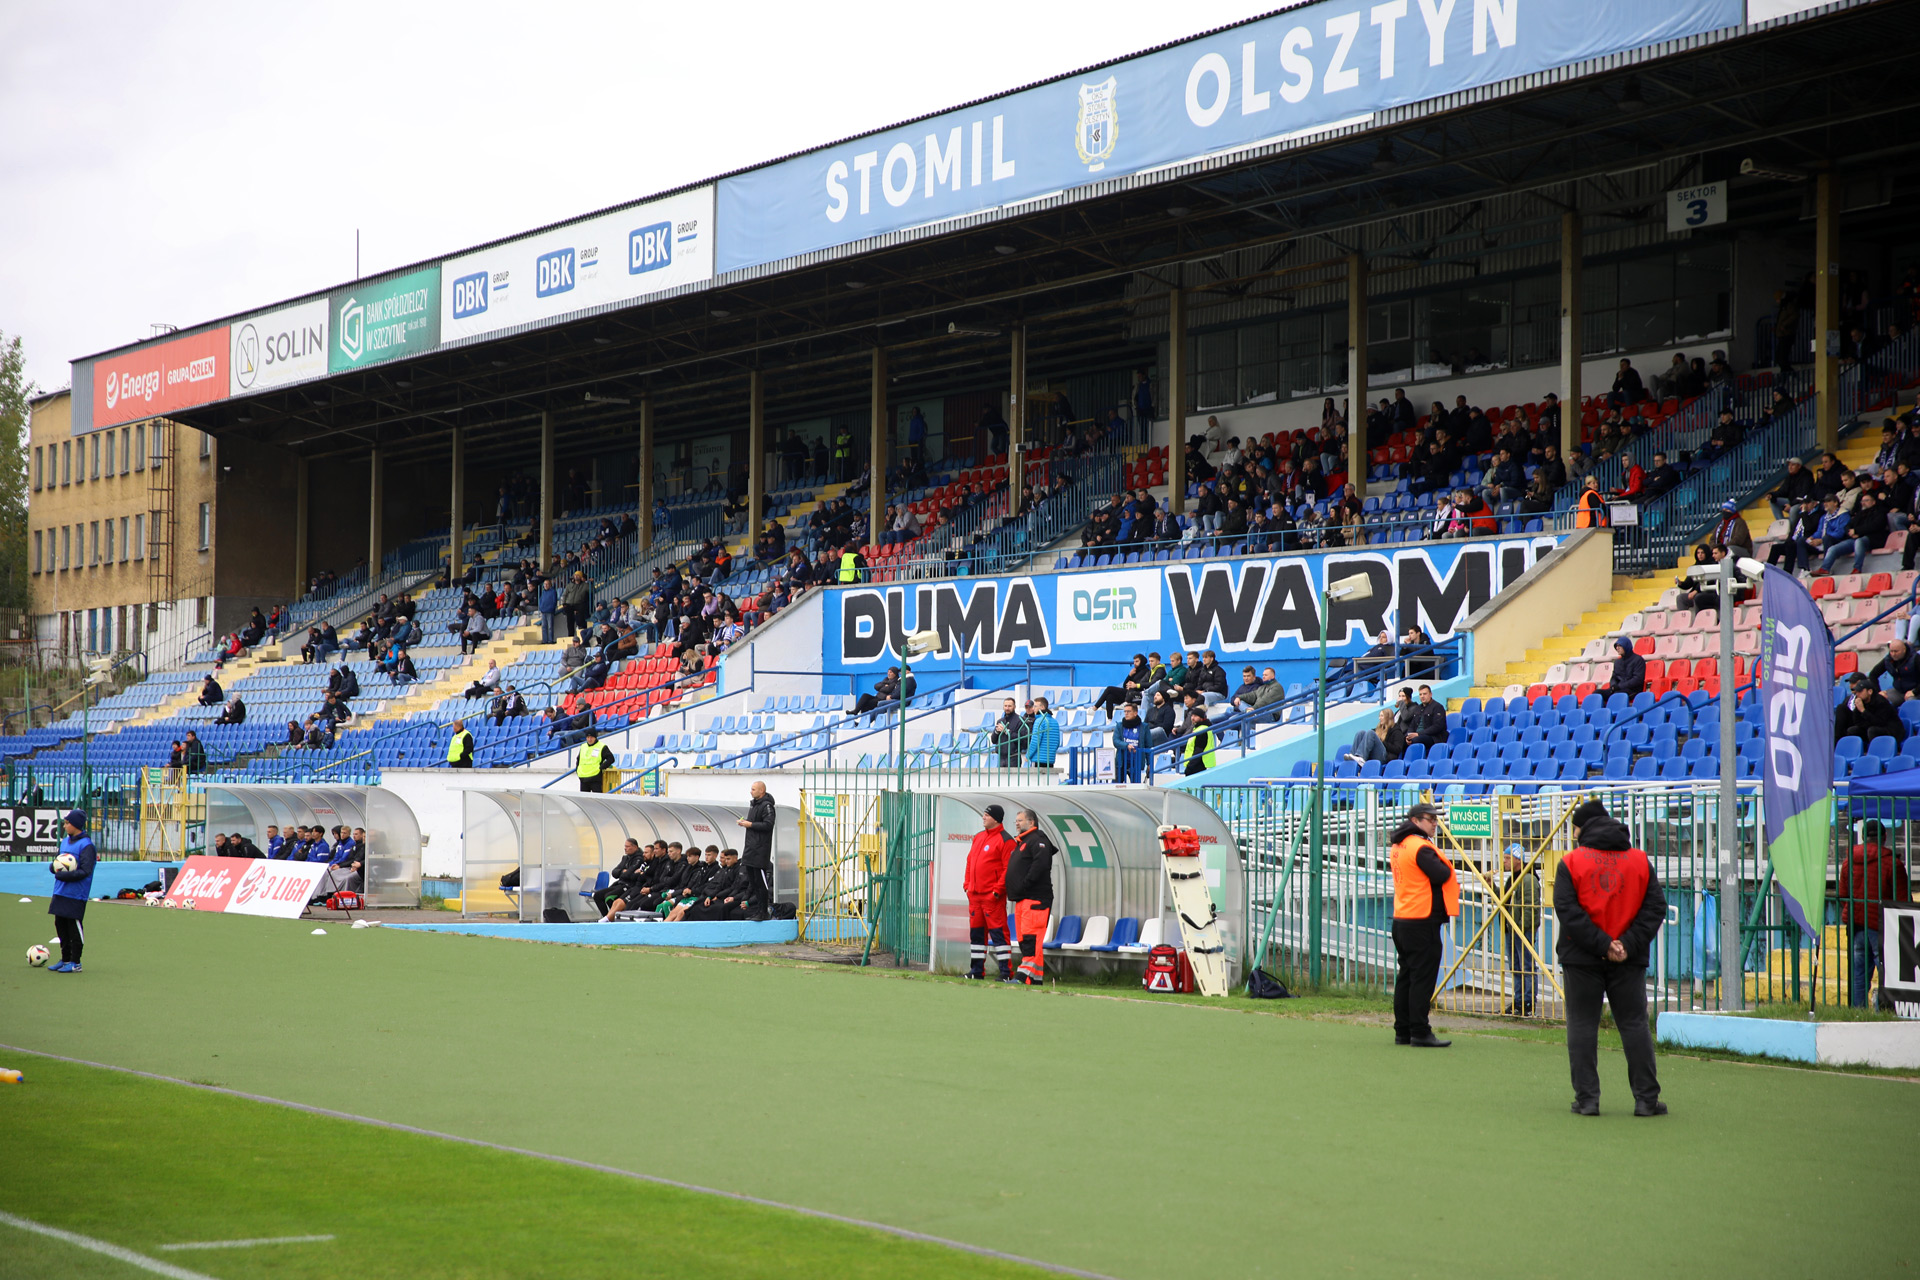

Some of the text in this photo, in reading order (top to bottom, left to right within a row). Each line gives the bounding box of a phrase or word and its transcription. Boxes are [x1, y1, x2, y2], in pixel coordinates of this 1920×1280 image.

[825, 0, 1517, 223] STOMIL OLSZTYN
[1084, 112, 1110, 125] OLSZTYN
[1088, 102, 1106, 112] STOMIL
[1677, 186, 1717, 202] SEKTOR
[1686, 199, 1708, 225] 3
[632, 220, 698, 269] DBK GROUP
[539, 253, 573, 292] DBK
[580, 246, 598, 260] GROUP
[367, 288, 428, 325] BANK SPÓŁDZIELCZY
[455, 270, 509, 314] DBK GROUP
[265, 322, 323, 365] SOLIN
[366, 322, 407, 351] W SZCZYTNIE
[121, 370, 160, 402] Energa
[167, 359, 214, 385] GRUPA ORLEN
[843, 538, 1556, 664] DUMA WARM
[1112, 622, 1137, 631] OLSZTYN
[1451, 824, 1490, 832] EWAKUACYJNE
[1452, 809, 1487, 821] WYJŚCIE
[173, 868, 231, 899] Betclic
[260, 876, 311, 903] 3 LIGA
